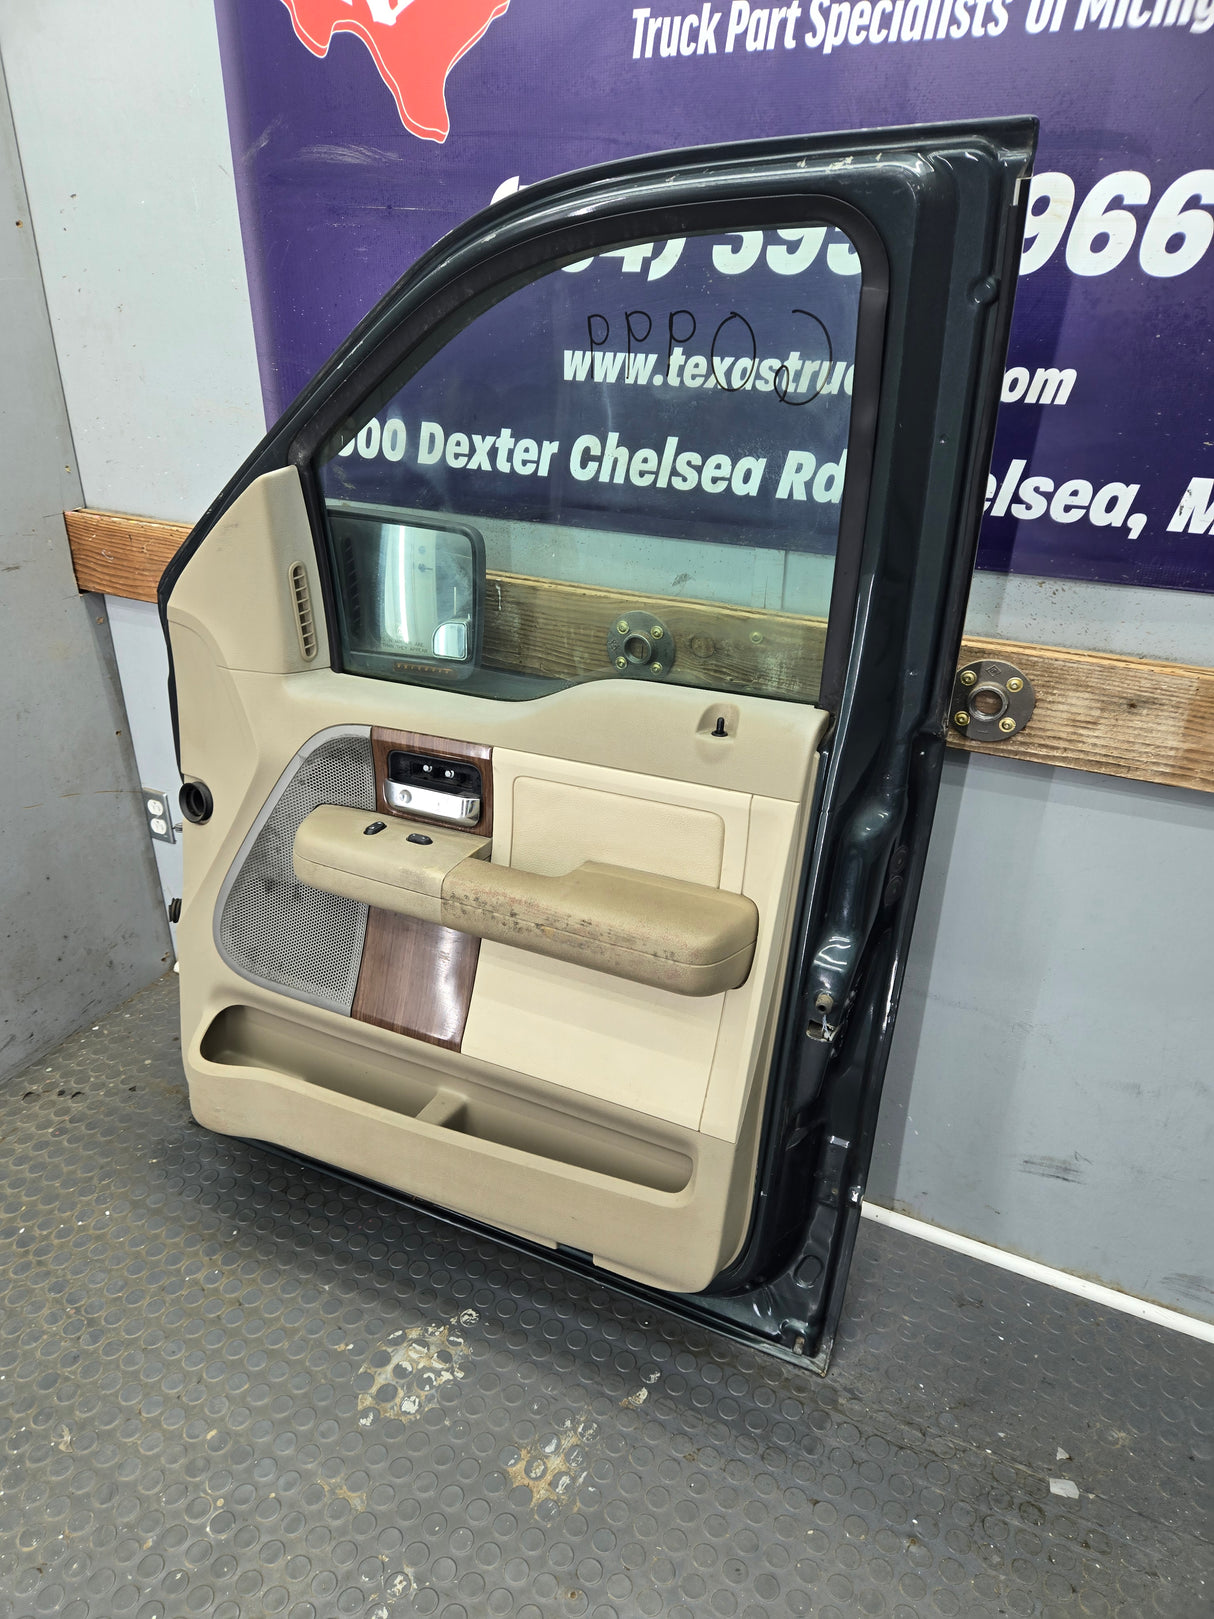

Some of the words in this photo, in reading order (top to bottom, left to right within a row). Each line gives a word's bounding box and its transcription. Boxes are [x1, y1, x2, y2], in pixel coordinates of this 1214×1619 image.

[632, 2, 722, 59] Truck
[725, 0, 802, 53] Part
[805, 0, 1012, 54] Specialists
[417, 421, 559, 477] Dexter
[570, 432, 767, 497] Chelsea
